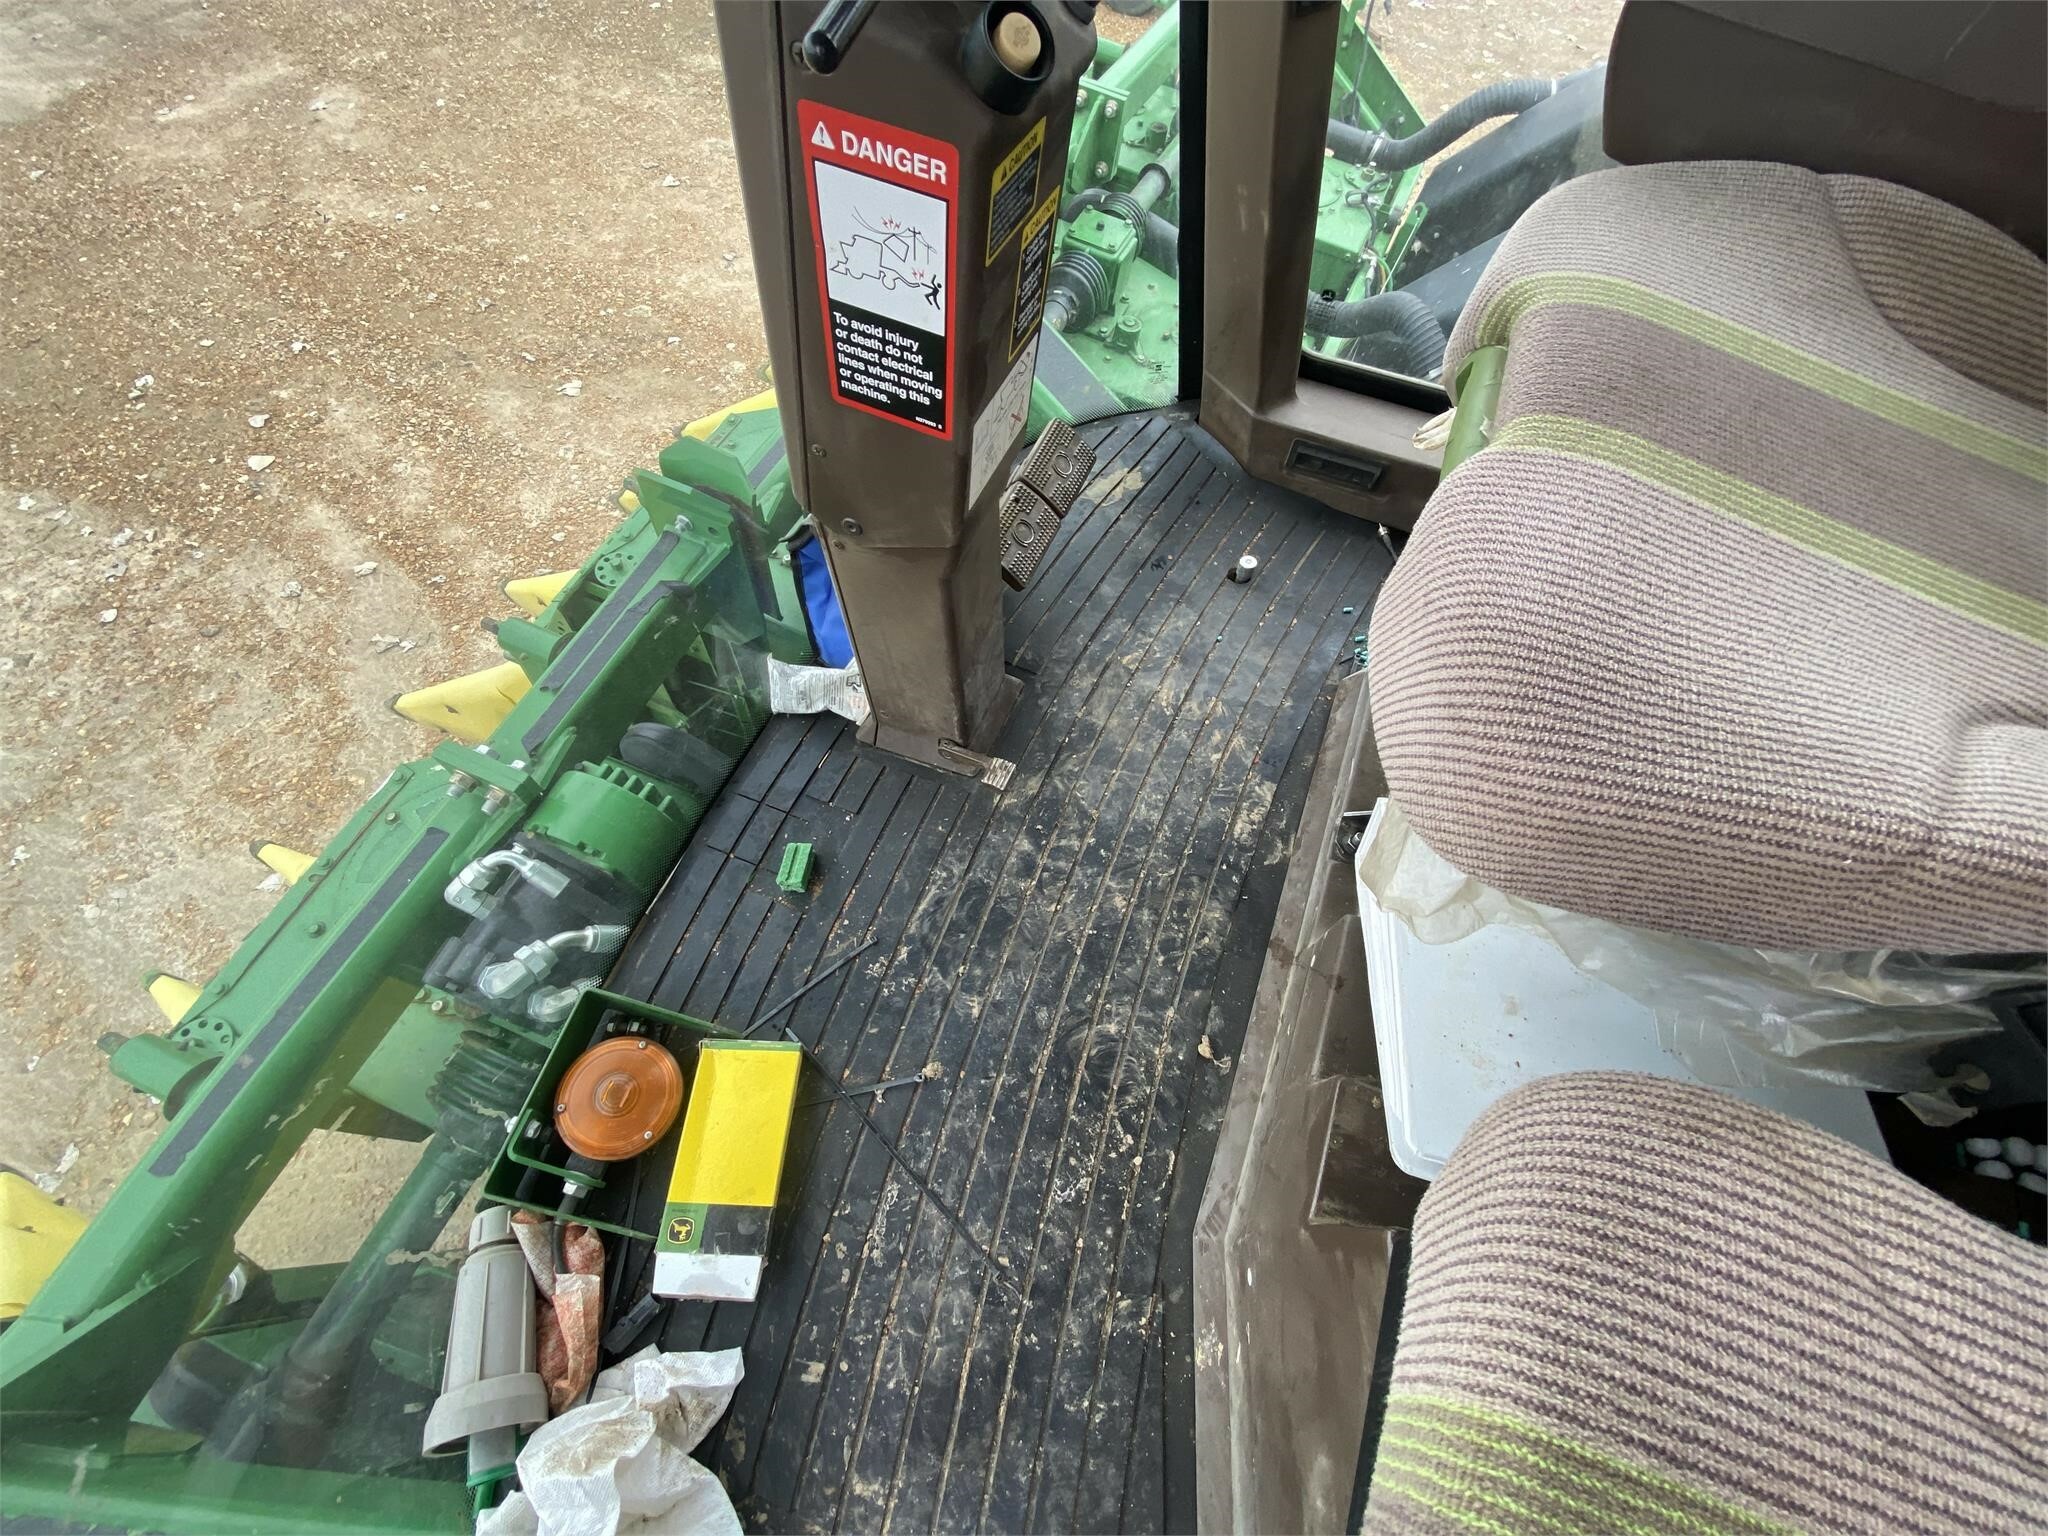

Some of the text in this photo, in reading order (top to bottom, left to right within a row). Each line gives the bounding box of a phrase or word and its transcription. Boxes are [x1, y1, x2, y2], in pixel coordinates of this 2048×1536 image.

[841, 130, 947, 185] DANGER
[1008, 133, 1038, 172] CAUTION
[833, 311, 919, 352] To avoid injury
[835, 328, 923, 365] or death do not
[836, 341, 933, 381] contact electrical
[838, 353, 943, 399] lines when moving
[839, 367, 930, 405] or operating this
[841, 380, 891, 404] machine.
